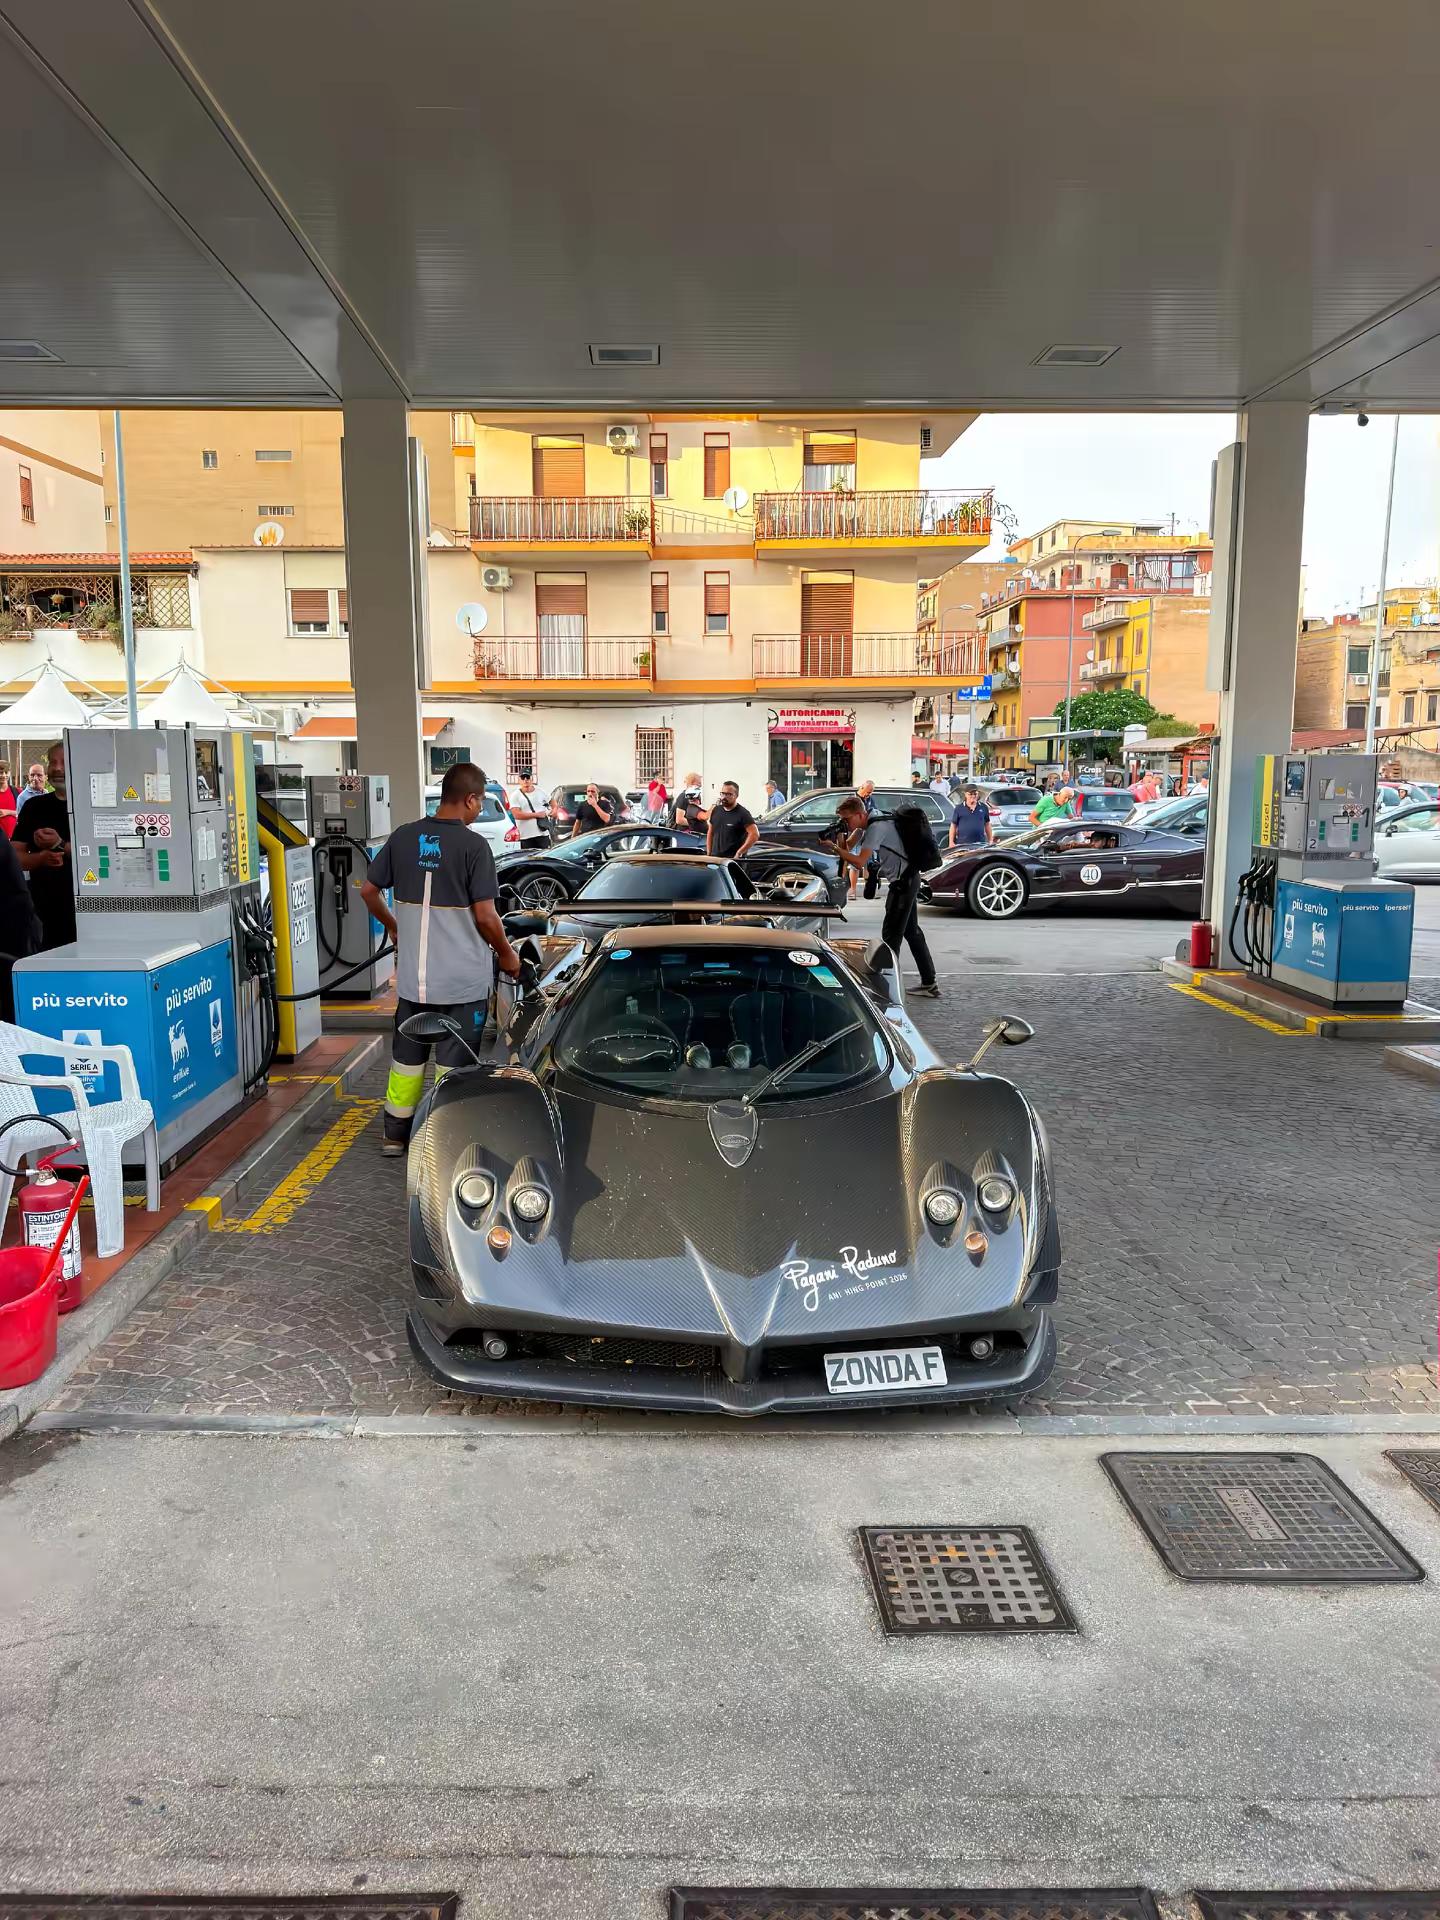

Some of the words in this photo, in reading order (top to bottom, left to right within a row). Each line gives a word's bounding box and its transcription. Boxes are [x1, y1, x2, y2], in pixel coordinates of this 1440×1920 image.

[1271, 804, 1279, 843] diesel
[1361, 807, 1370, 828] 1
[227, 813, 238, 877] diesel
[238, 812, 248, 875] diesel
[1309, 838, 1317, 849] 2
[1082, 868, 1099, 881] 40
[1292, 898, 1303, 911] più
[1303, 903, 1328, 917] servito
[1354, 903, 1380, 911] servito
[792, 953, 813, 962] 87
[32, 992, 61, 1011] più
[65, 992, 128, 1007] servito
[166, 988, 181, 1017] più
[183, 976, 212, 1004] servito
[779, 1260, 840, 1312] Pagani
[839, 1245, 897, 1280] Raduno
[865, 1277, 888, 1291] POINT
[827, 1353, 921, 1388] ZONDA
[922, 1351, 940, 1380] F
